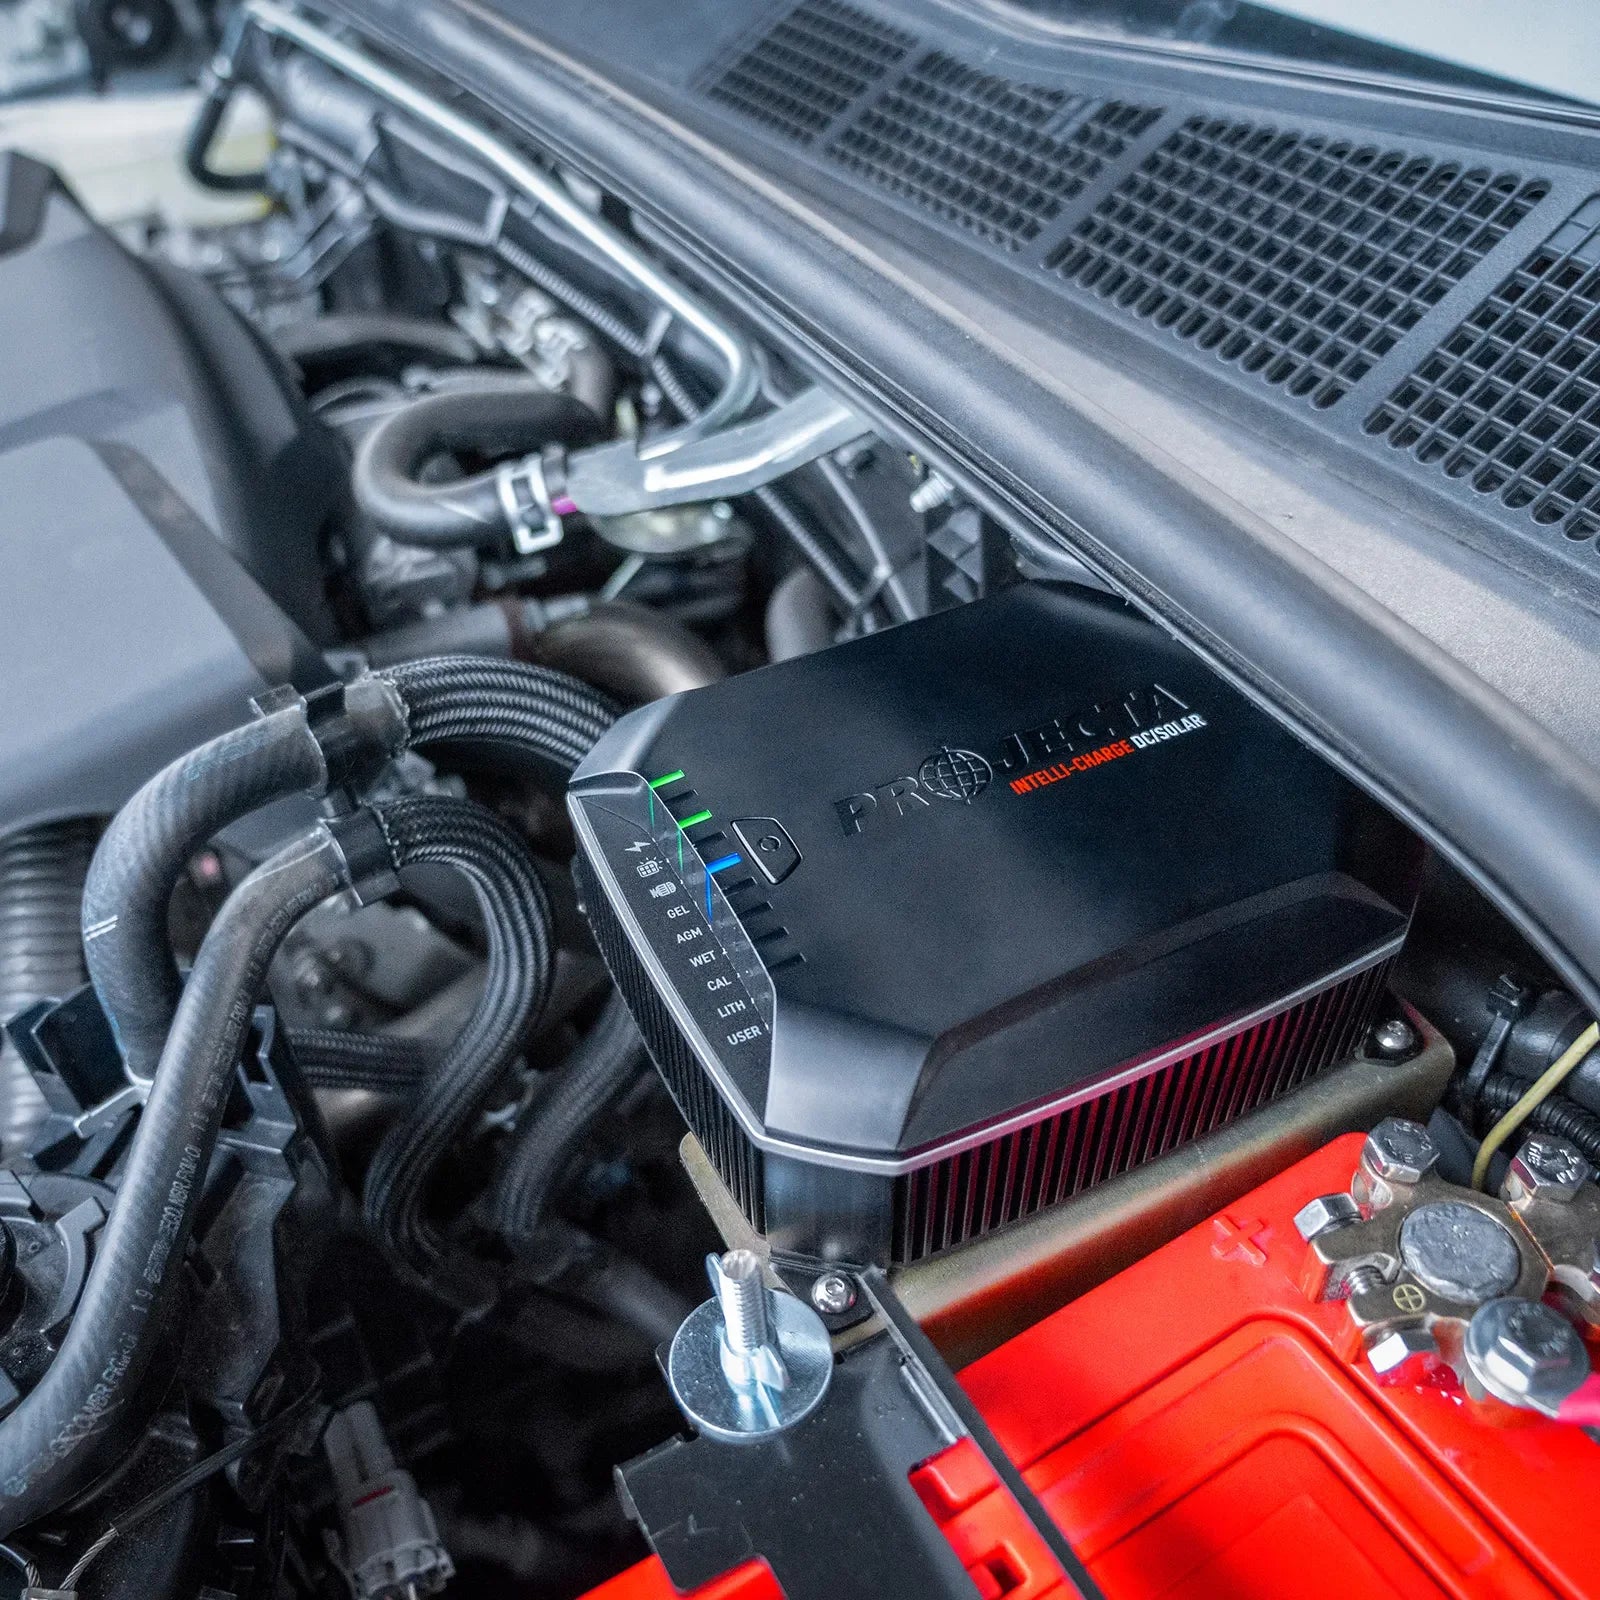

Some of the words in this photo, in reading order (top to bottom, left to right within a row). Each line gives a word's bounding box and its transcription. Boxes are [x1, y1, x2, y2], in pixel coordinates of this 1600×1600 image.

[1009, 738, 1135, 796] INTELLI-CHARGE
[1130, 713, 1207, 750] DC/SOLAR
[666, 904, 690, 919] GEL
[676, 926, 703, 944] AGM
[689, 950, 716, 968] WET
[707, 976, 732, 991] CAL
[717, 999, 746, 1018] LITH
[726, 1025, 762, 1046] USER
